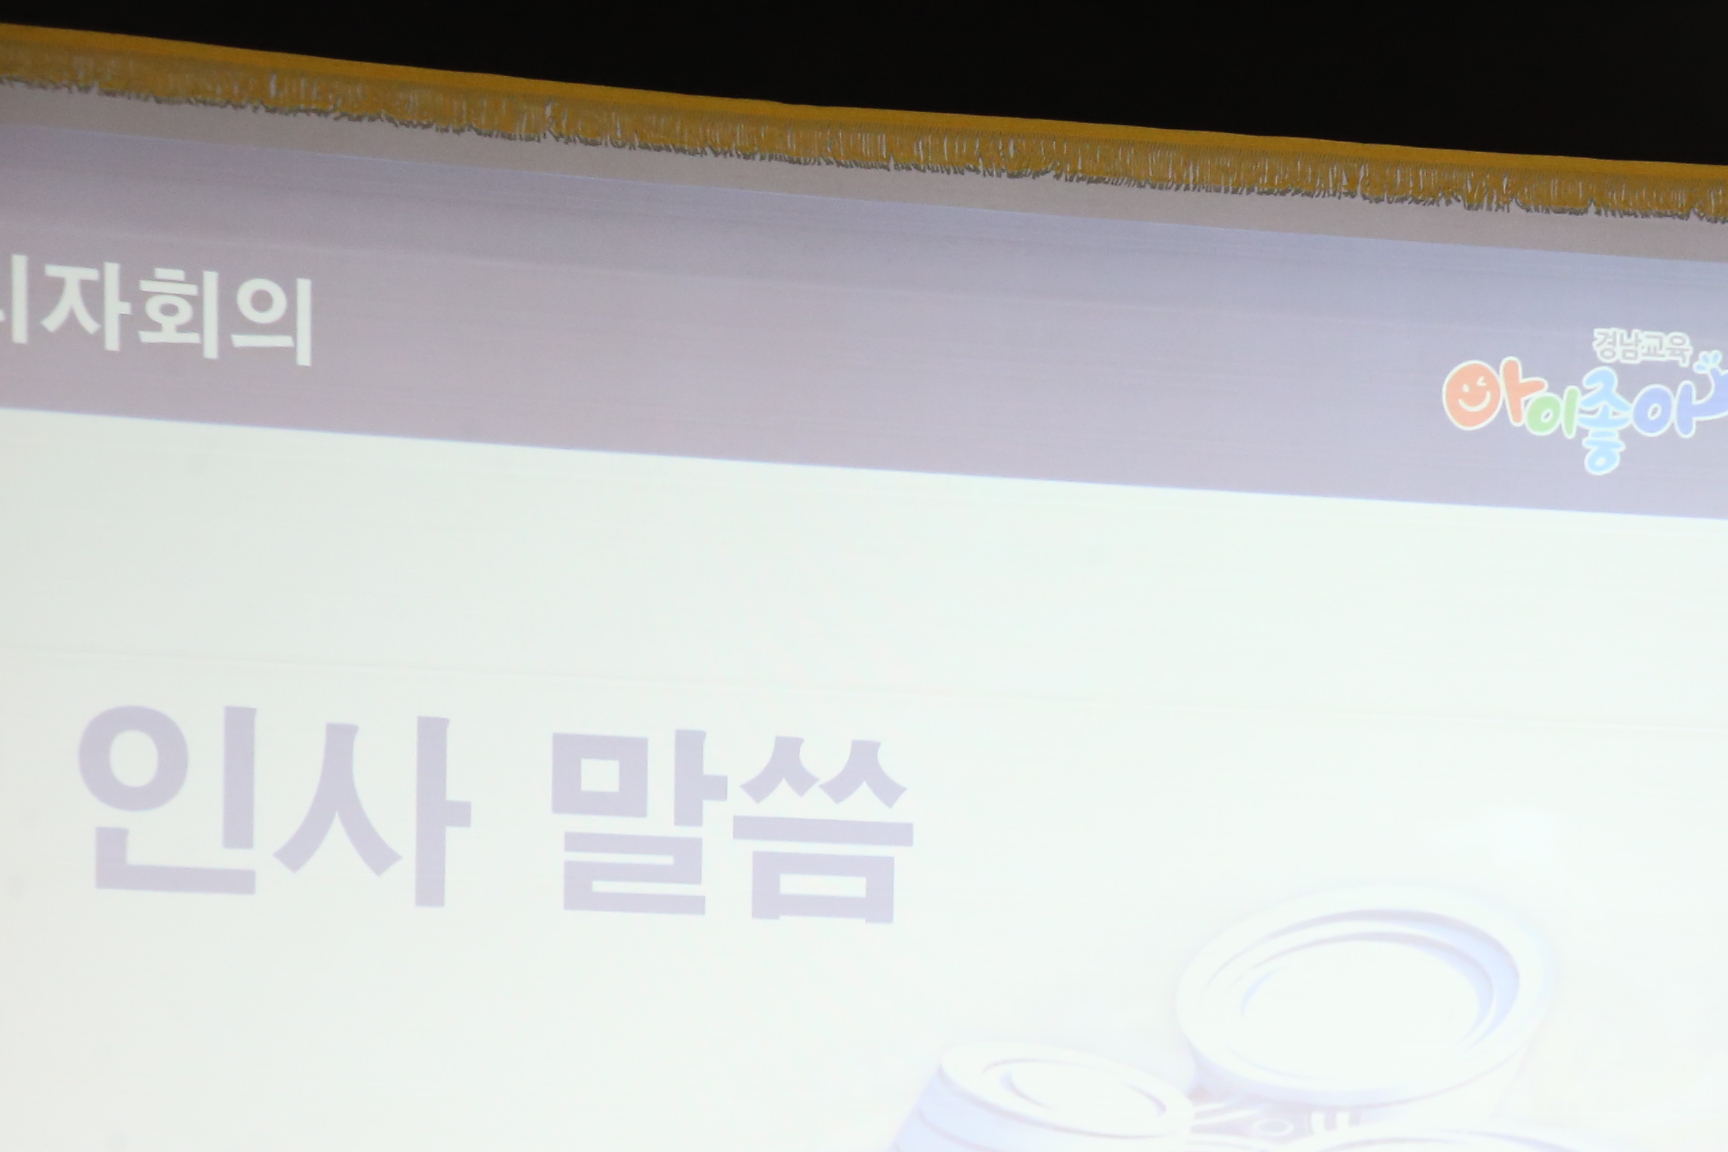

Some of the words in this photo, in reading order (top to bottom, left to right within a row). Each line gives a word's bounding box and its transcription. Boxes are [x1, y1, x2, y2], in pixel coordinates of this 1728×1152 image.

[1593, 328, 1693, 367] 경남교육
[78, 705, 472, 908] 인사
[551, 729, 914, 924] 말씀
